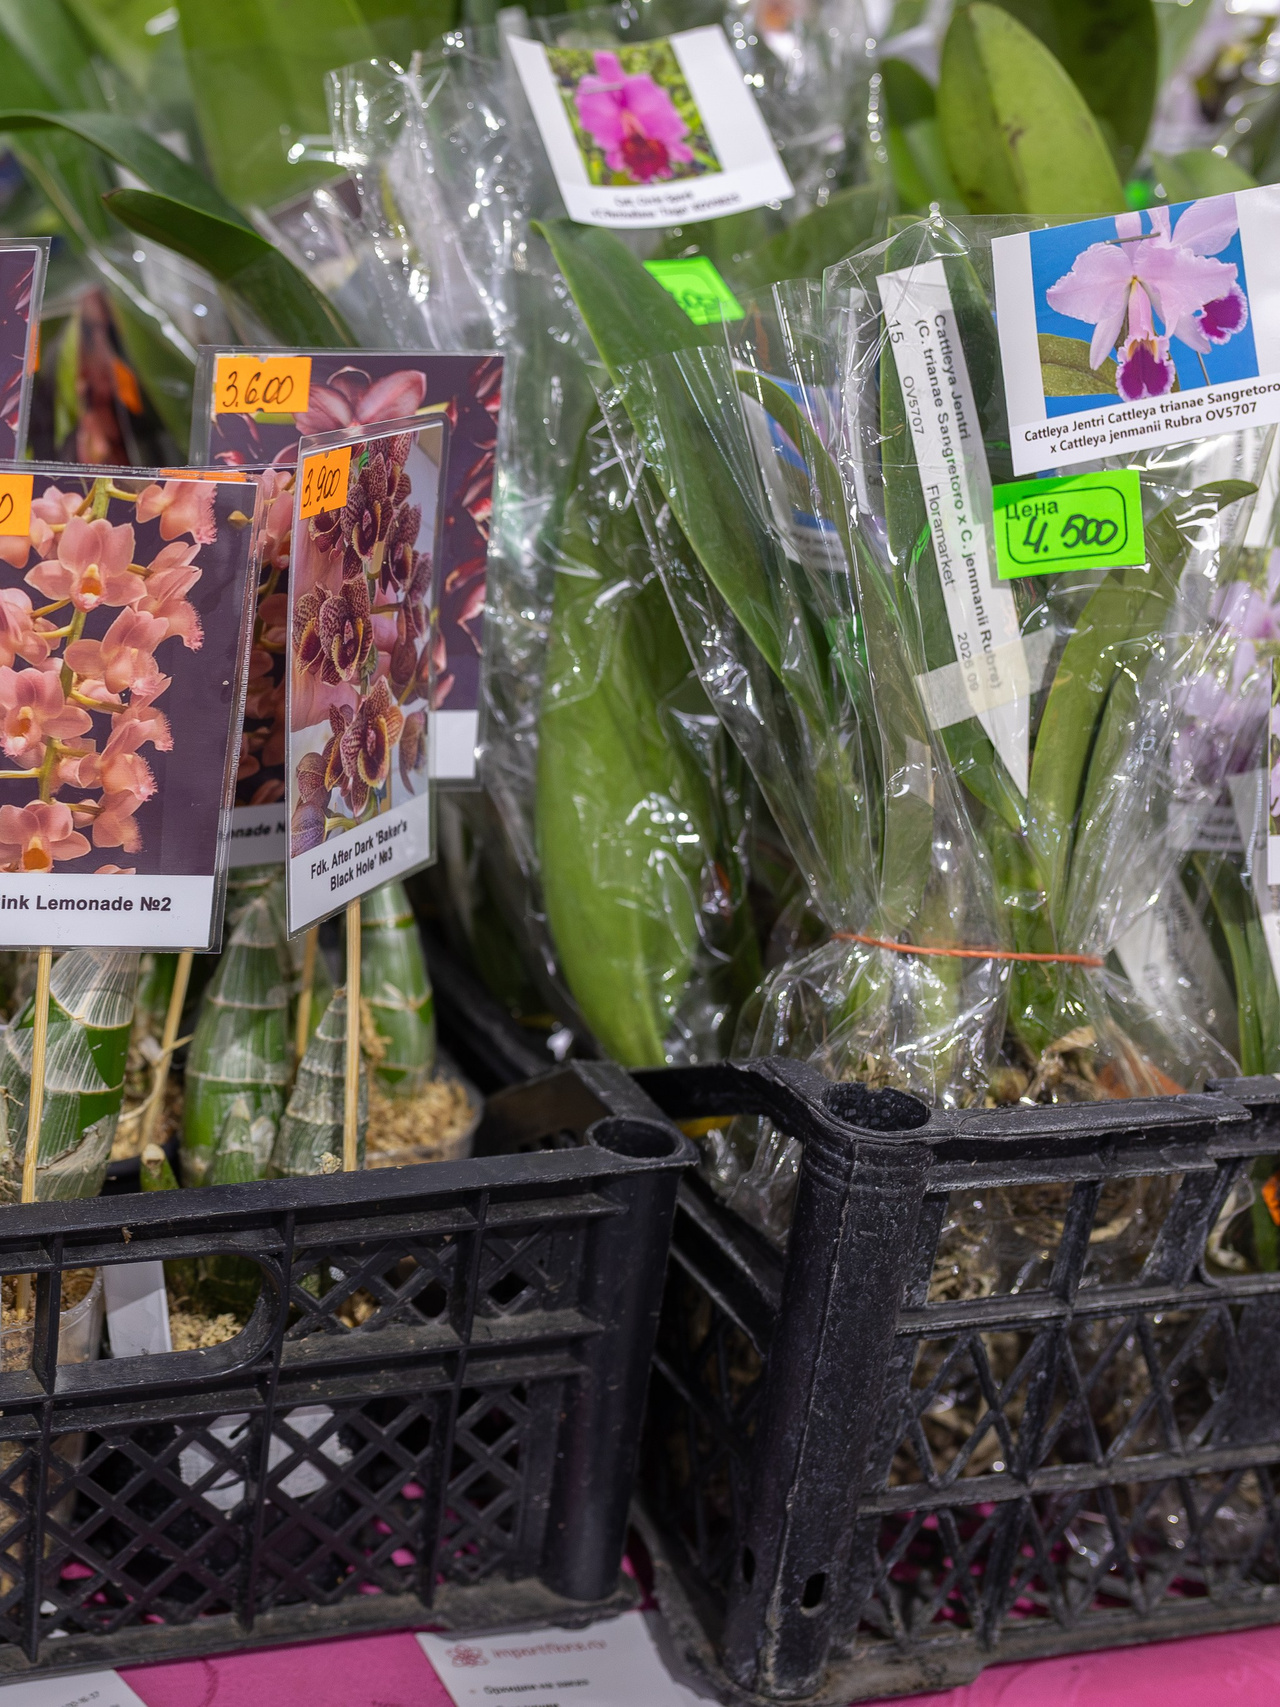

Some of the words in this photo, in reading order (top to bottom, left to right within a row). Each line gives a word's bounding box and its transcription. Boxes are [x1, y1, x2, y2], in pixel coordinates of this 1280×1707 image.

[934, 314, 957, 386] Cattleya
[951, 391, 972, 440] Jentri
[1024, 423, 1070, 442] Cattleya
[1072, 413, 1105, 434] Jentri
[1107, 406, 1157, 426] Cattleya
[1159, 396, 1205, 414] trianae
[1207, 382, 1280, 405] Sangretoro
[1049, 443, 1058, 454] x
[1059, 432, 1107, 452] Cattleya
[1108, 421, 1162, 444] jenmanii
[1164, 413, 1203, 430] Rubra
[1205, 400, 1258, 422] OV5707
[888, 319, 905, 344] 15
[902, 375, 925, 436] OV5707
[926, 484, 956, 588] Floramarket
[914, 319, 931, 345] (C.
[923, 347, 944, 408] trianae
[937, 411, 965, 511] Sangretoro
[961, 551, 990, 627] jenmanii
[1005, 500, 1059, 520] Цена
[310, 858, 330, 880] Fdk.
[331, 847, 353, 869] After
[354, 835, 374, 857] Dark
[330, 866, 354, 892] Black
[355, 853, 377, 878] Hole'
[35, 895, 134, 911] Lemonade
[140, 896, 172, 912] №2
